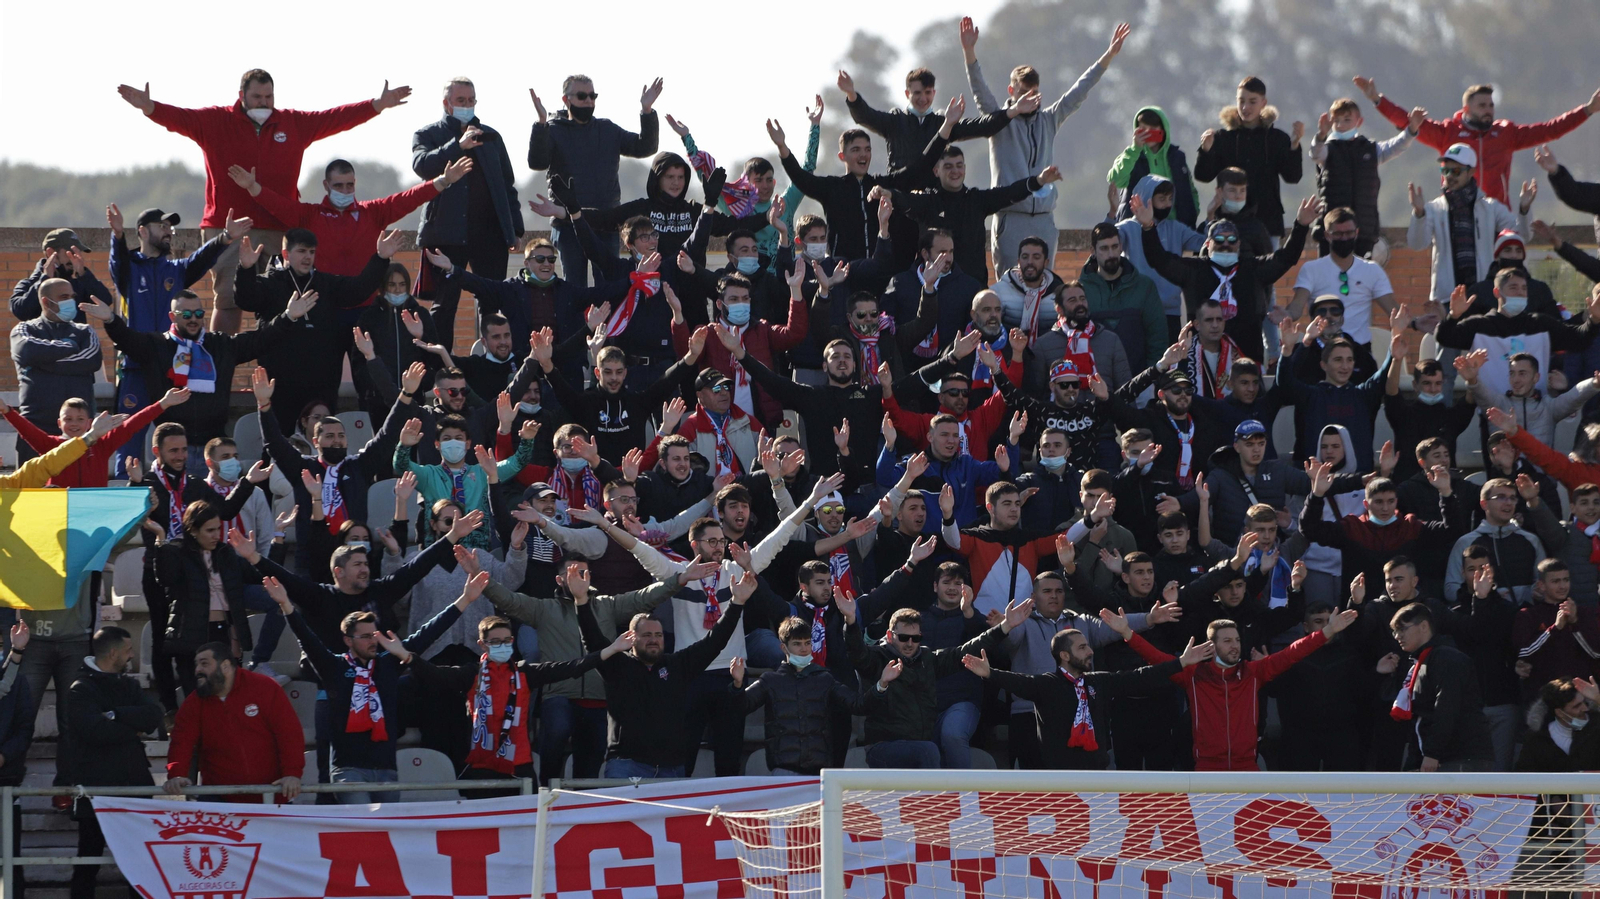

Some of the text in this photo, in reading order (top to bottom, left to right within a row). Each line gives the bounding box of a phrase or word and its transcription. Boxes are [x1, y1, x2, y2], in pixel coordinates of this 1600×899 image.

[1046, 416, 1093, 432] adidas
[36, 619, 54, 637] 85
[178, 881, 238, 891] ALGECIRAS C.F.
